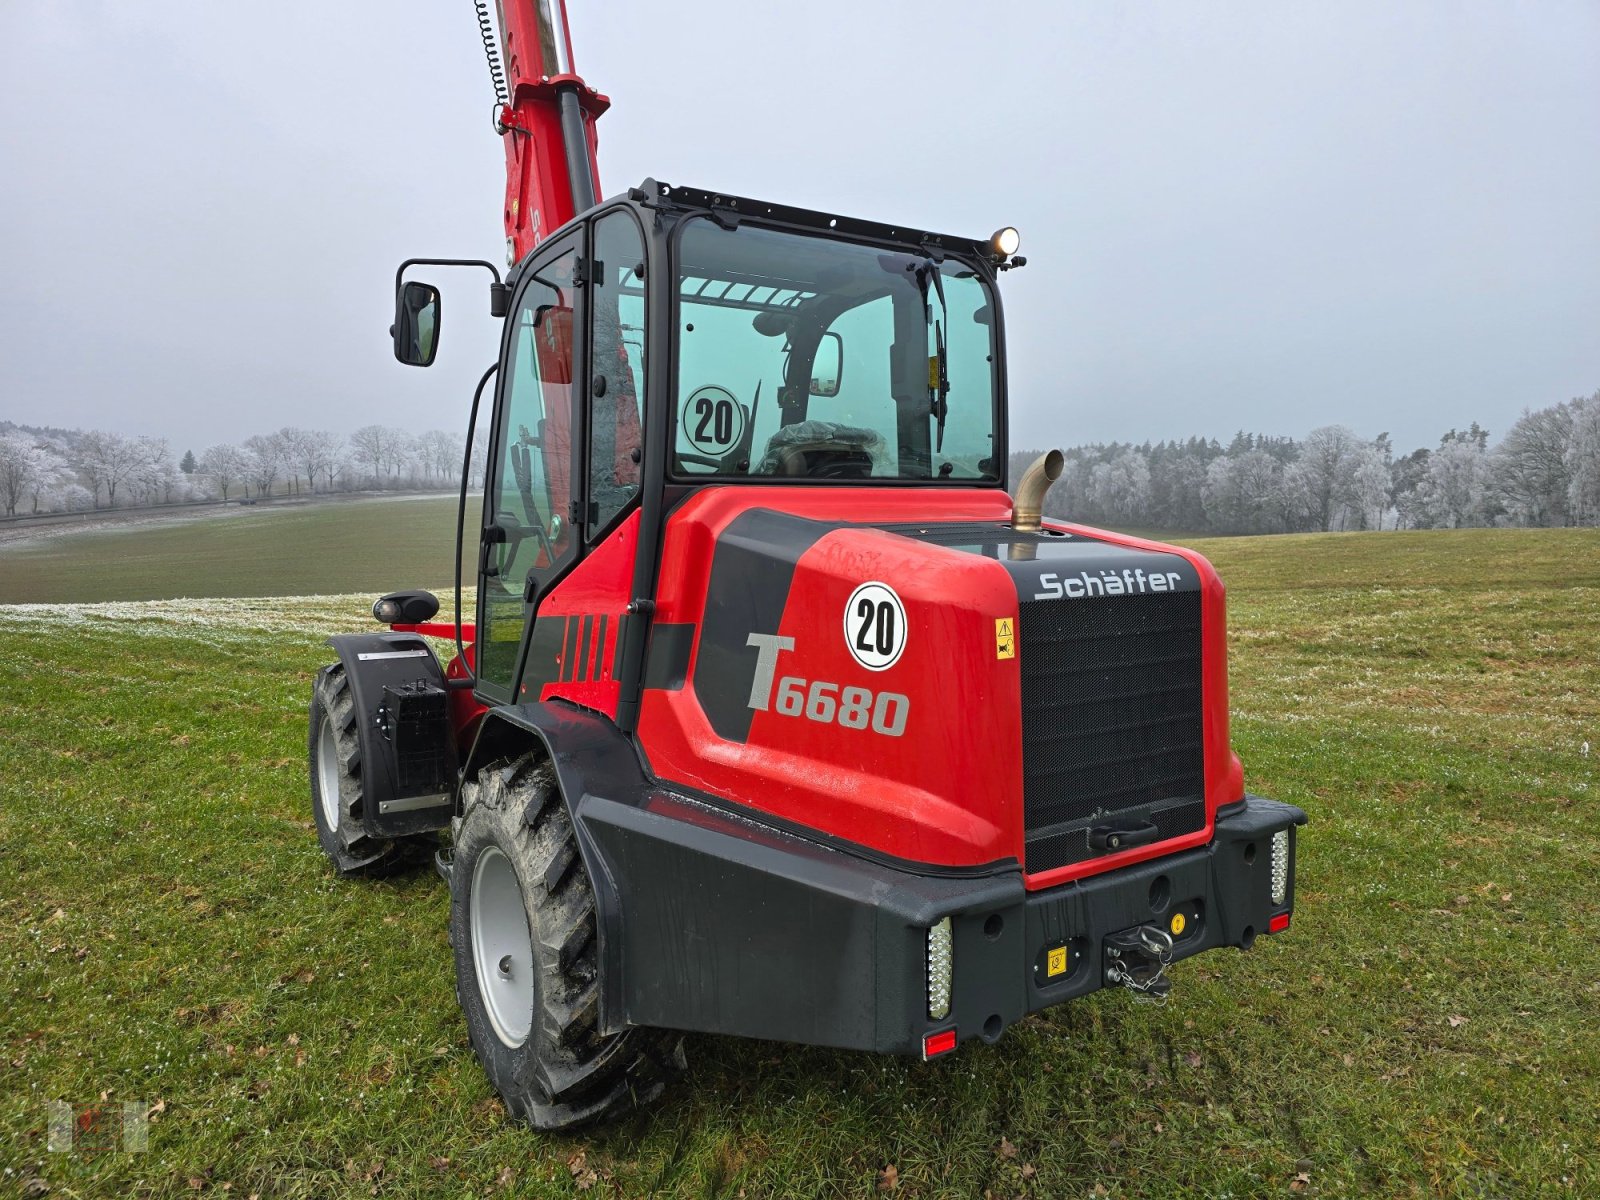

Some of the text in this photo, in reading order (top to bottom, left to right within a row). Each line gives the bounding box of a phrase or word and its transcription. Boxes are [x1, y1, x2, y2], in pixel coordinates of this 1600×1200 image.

[695, 398, 733, 445] 20
[1034, 568, 1181, 600] Schäffer
[856, 598, 895, 656] 20
